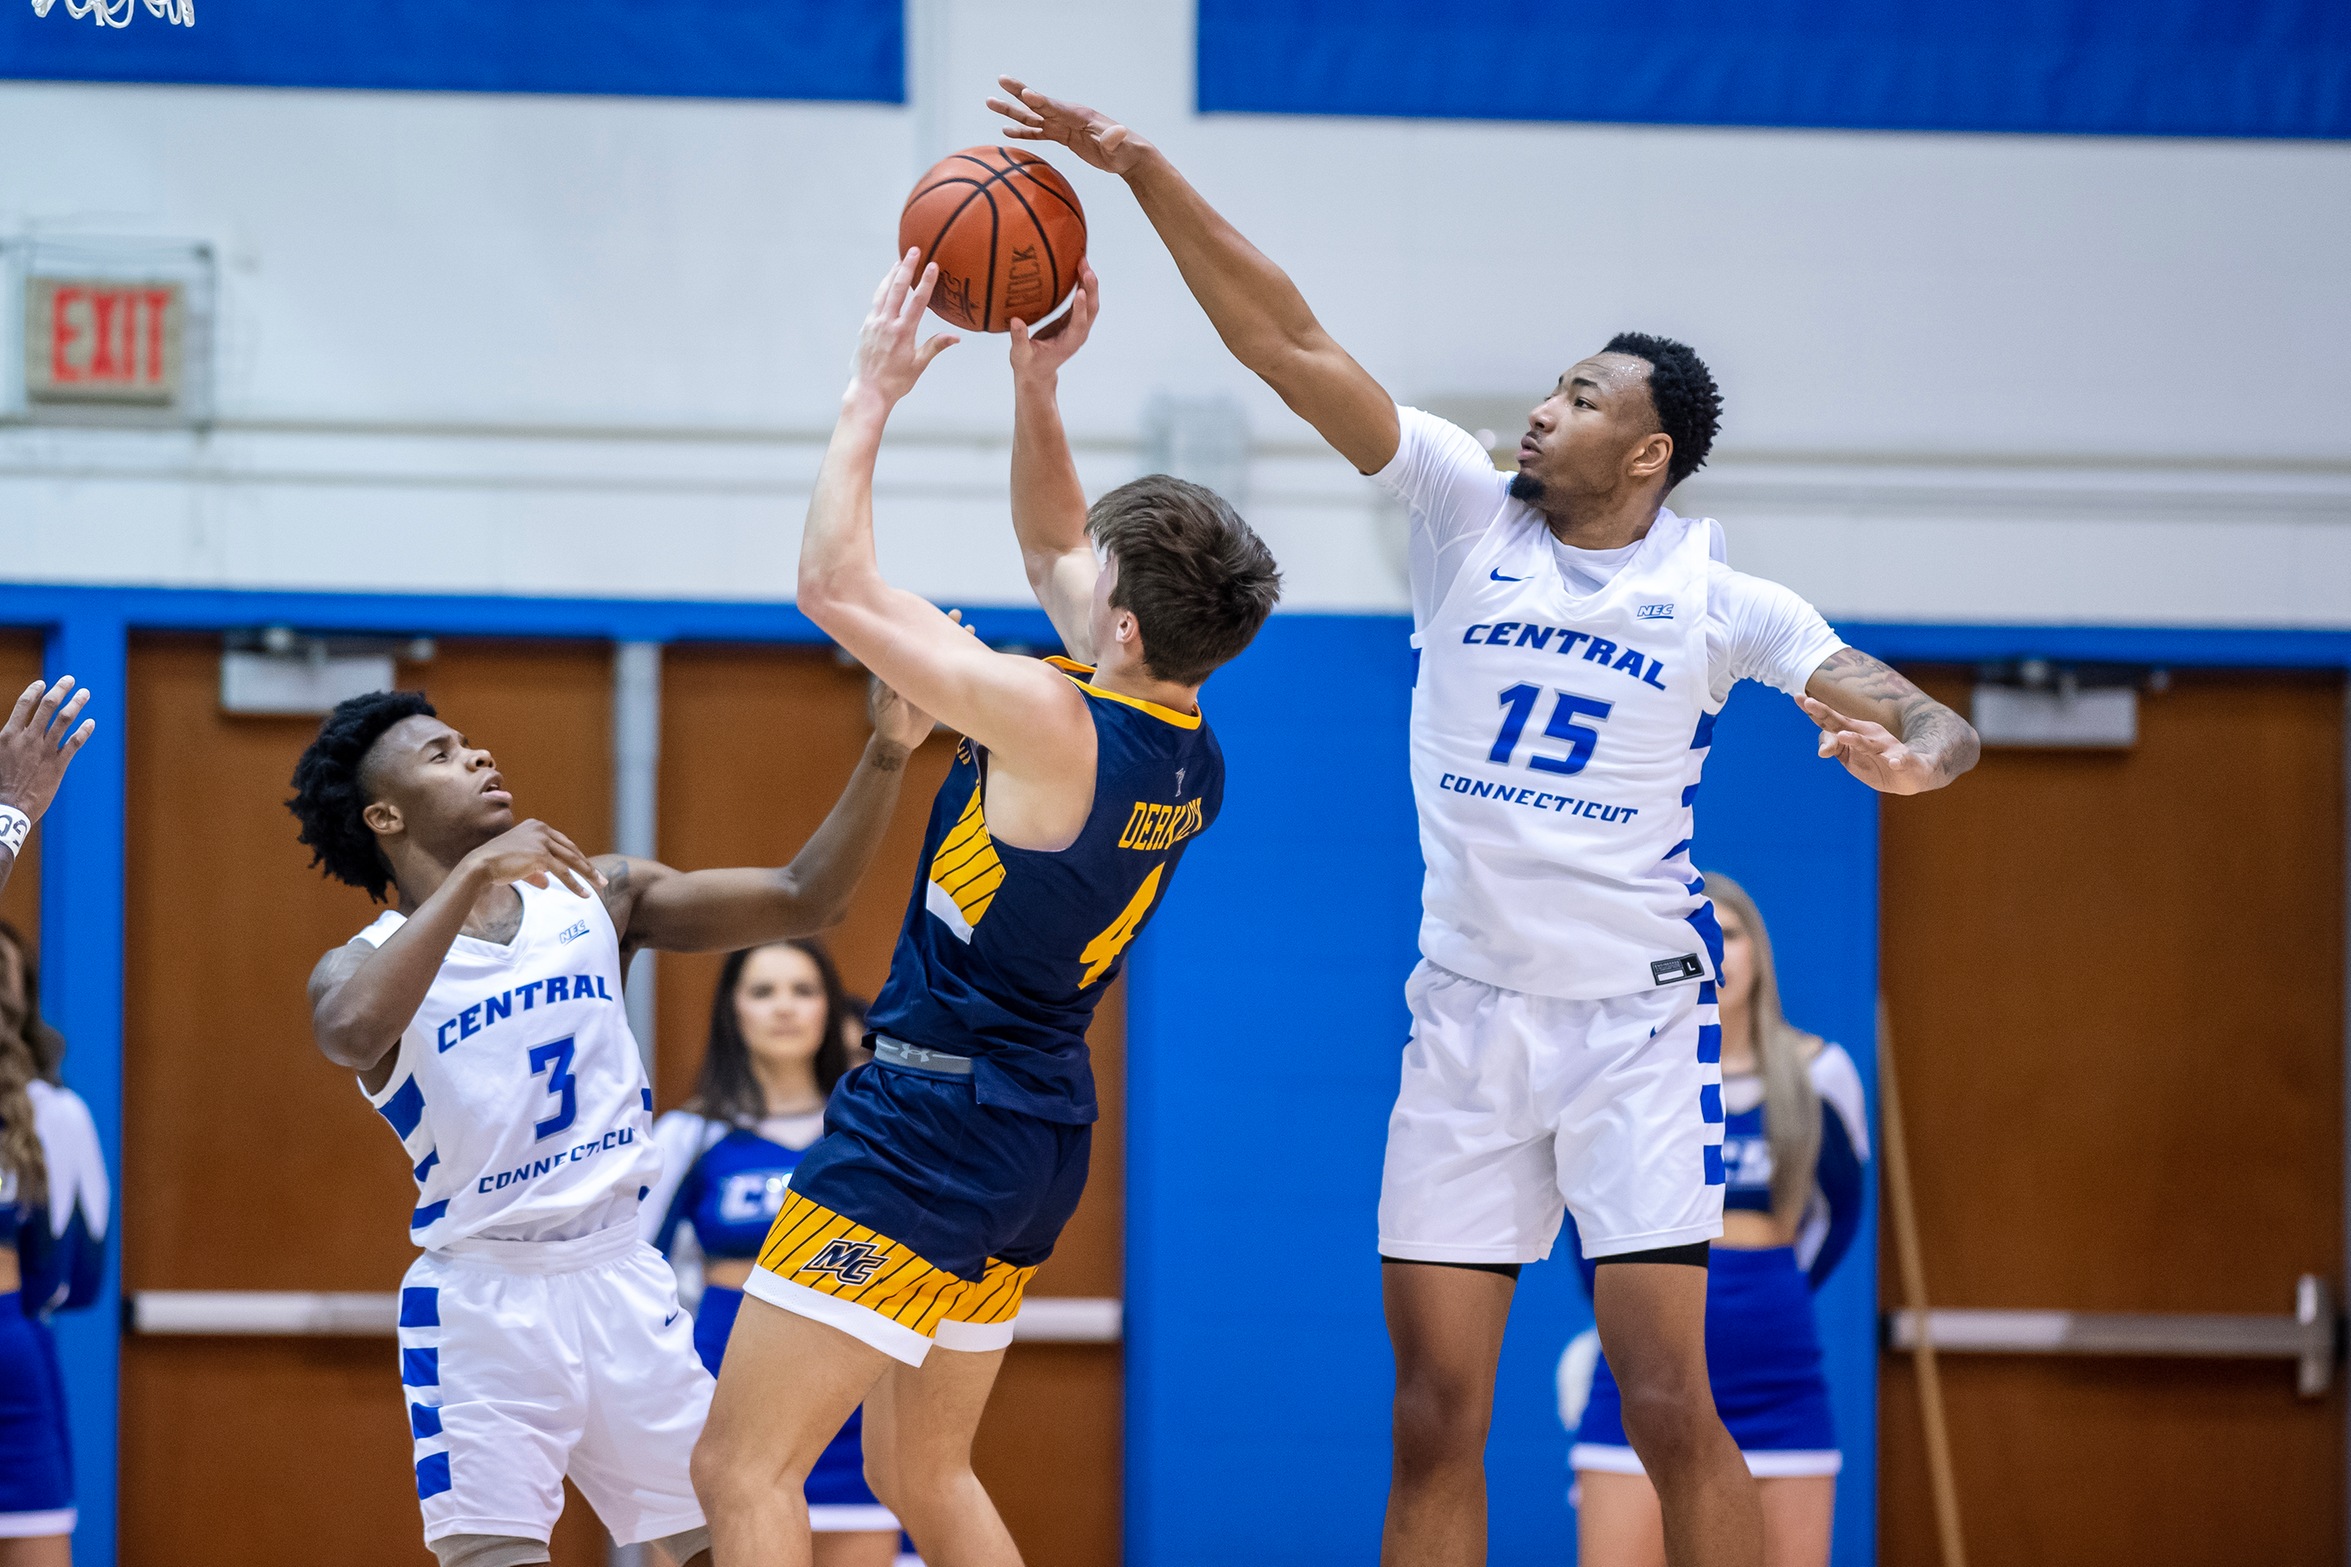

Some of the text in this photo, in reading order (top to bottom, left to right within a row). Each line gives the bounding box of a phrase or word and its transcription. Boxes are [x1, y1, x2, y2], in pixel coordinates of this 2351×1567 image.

[52, 287, 171, 383] EXIT
[1636, 604, 1674, 618] NEC
[1462, 622, 1667, 691] CENTRAL
[1485, 680, 1616, 778] 15
[1440, 772, 1638, 824] CONNECTICUT
[559, 920, 586, 944] NEC
[1078, 861, 1166, 990] 4
[437, 974, 613, 1054] CENTRAL
[527, 1033, 578, 1144] 3
[477, 1126, 636, 1194] CONNECTICU
[800, 1238, 890, 1286] MC
